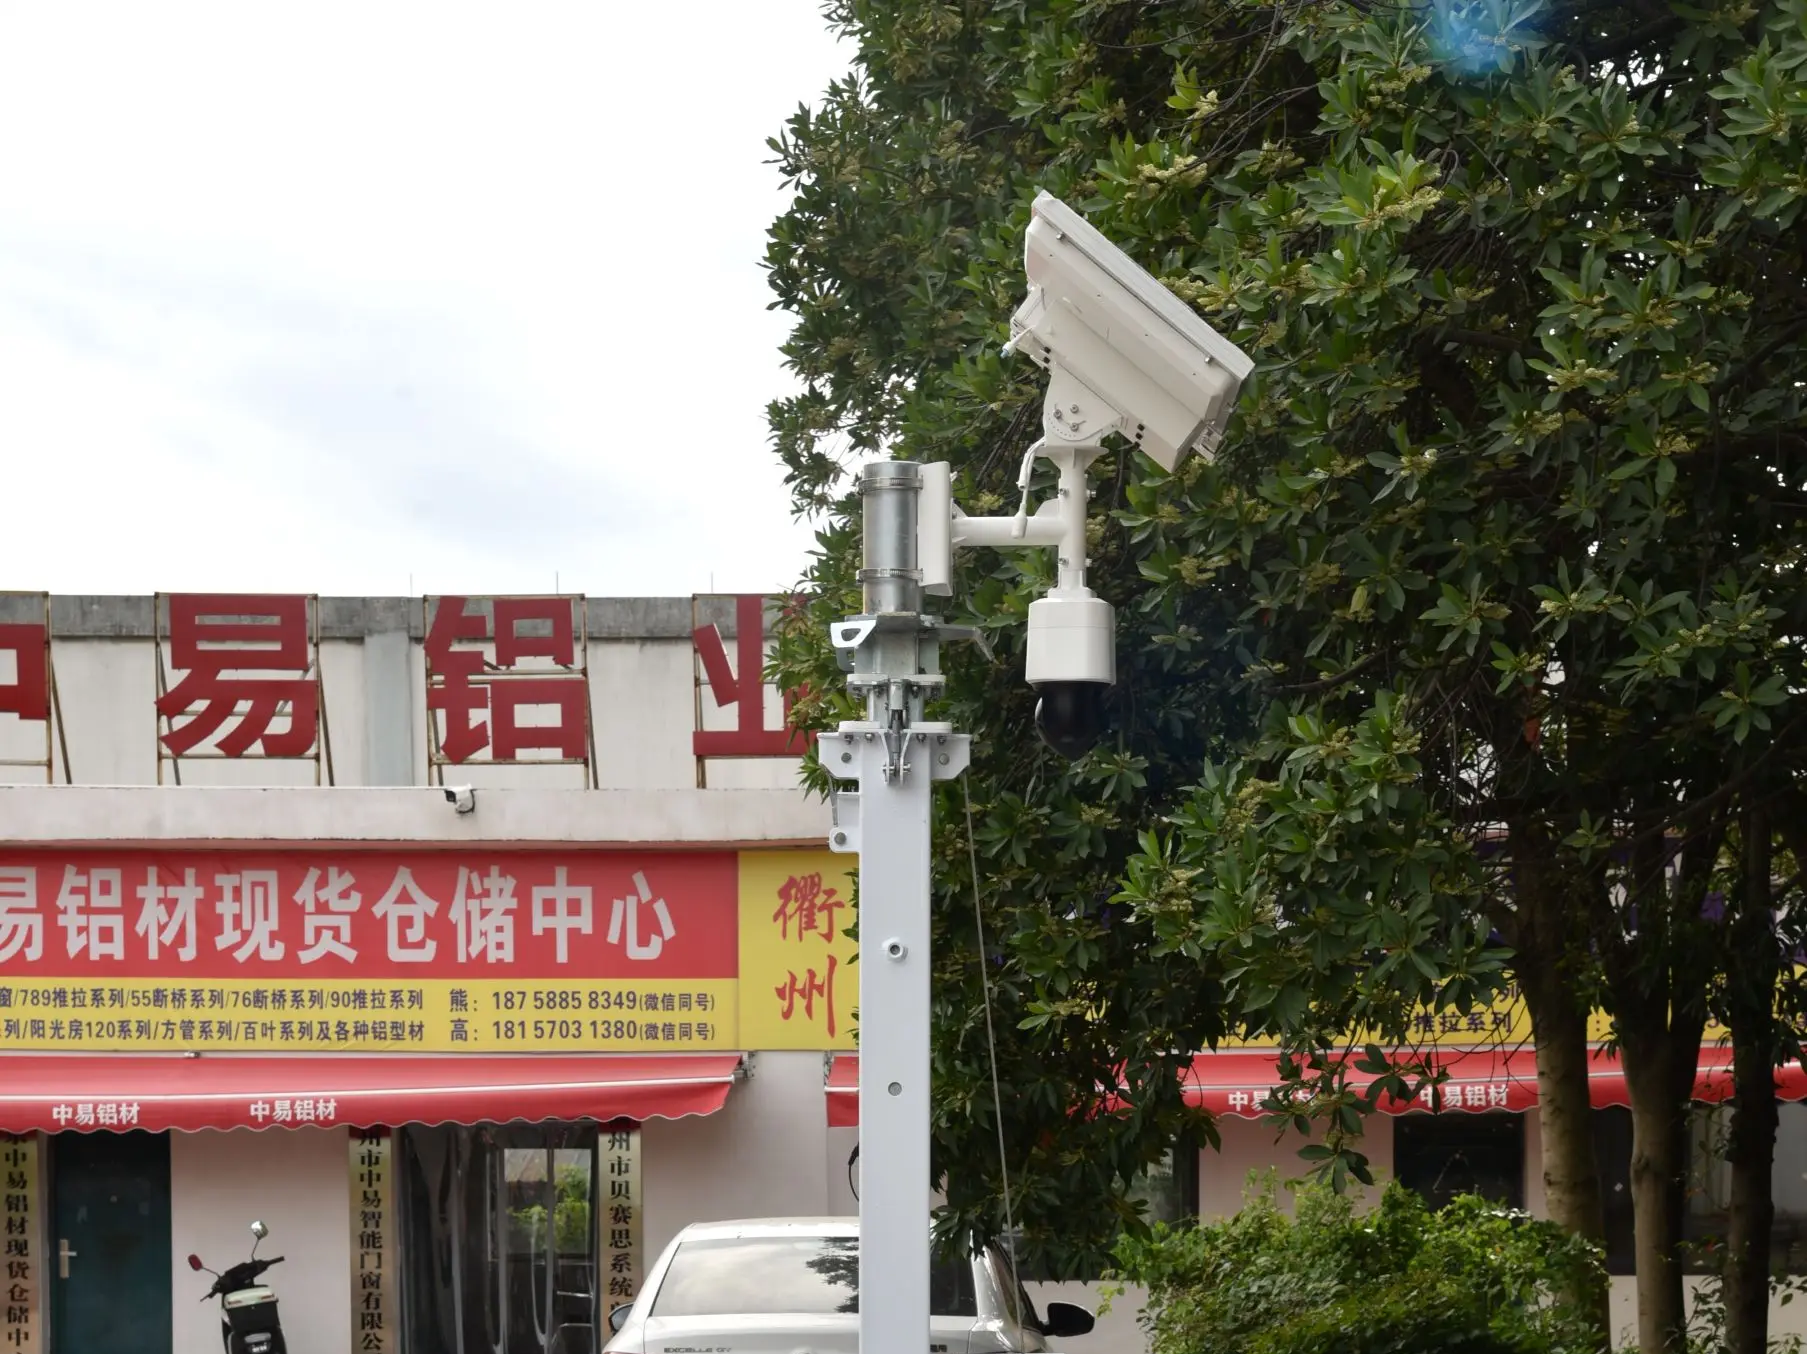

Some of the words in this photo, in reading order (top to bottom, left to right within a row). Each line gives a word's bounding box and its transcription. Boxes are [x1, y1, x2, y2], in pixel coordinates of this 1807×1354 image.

[0, 865, 676, 964] 易铝材现货仓储中心
[772, 871, 845, 1039] 衢州
[492, 990, 527, 1010] 187
[533, 990, 582, 1010] 5885
[492, 1020, 527, 1040] 181
[533, 1020, 582, 1040] 5703
[52, 1103, 141, 1125] 中易铝材
[249, 1098, 337, 1122] 中易铝材
[608, 1129, 633, 1308] 州市贝赛思系统
